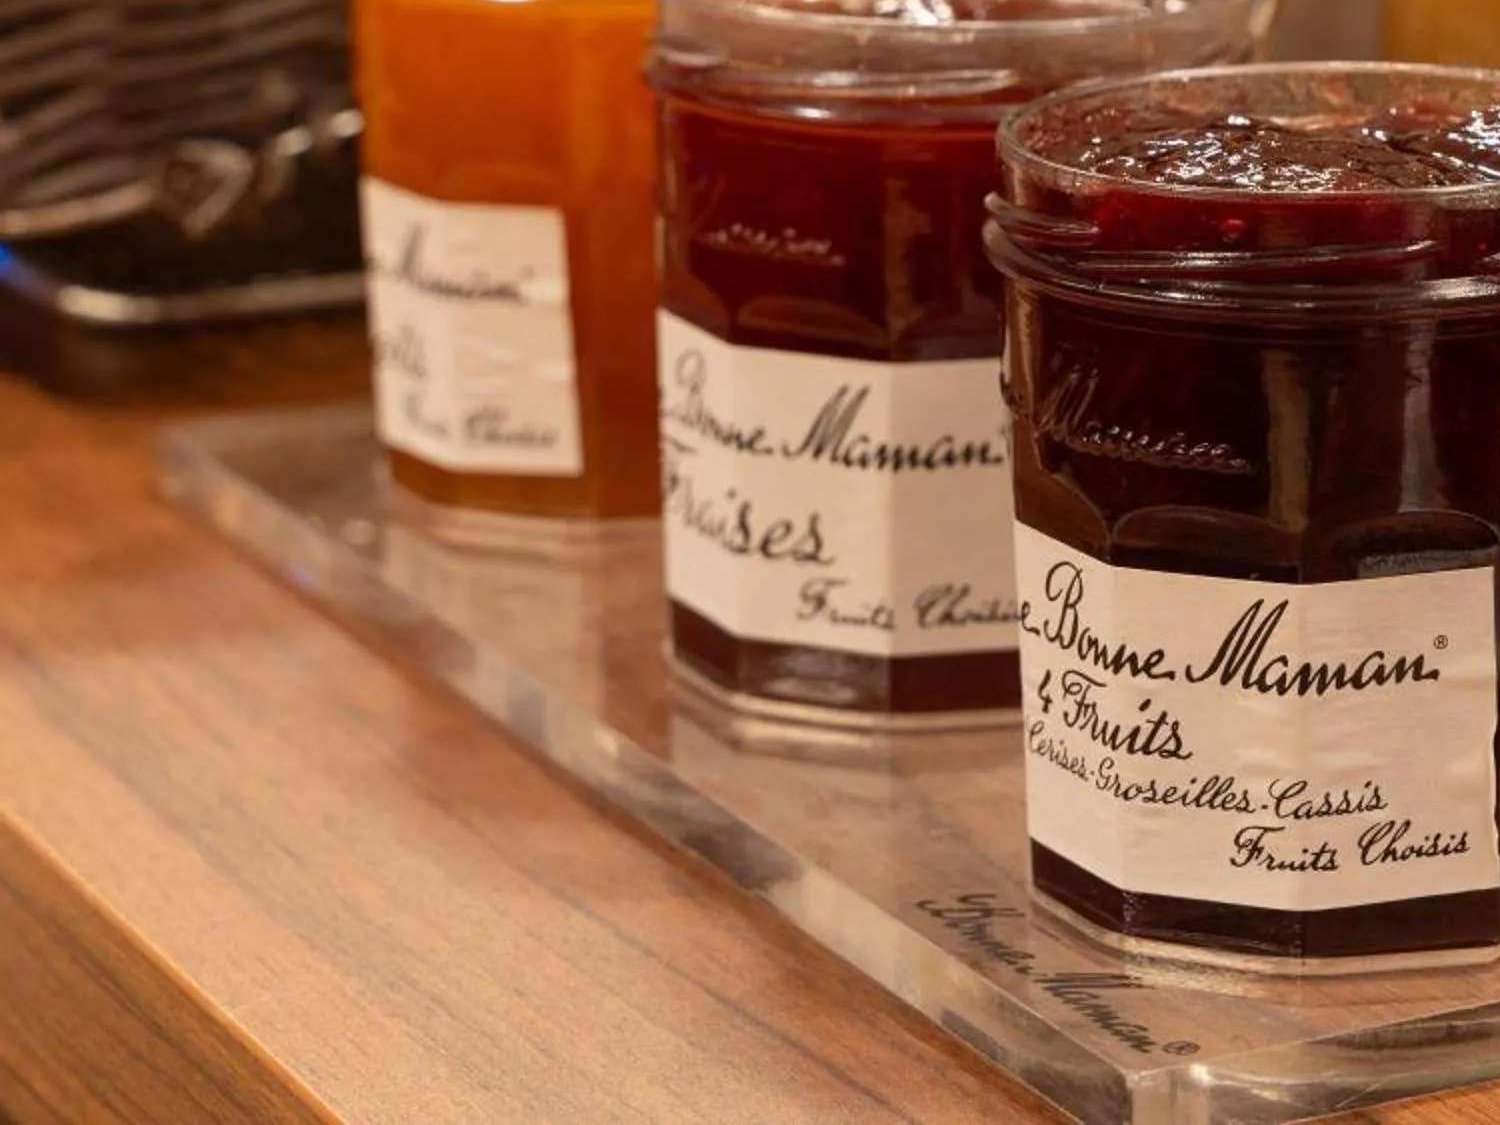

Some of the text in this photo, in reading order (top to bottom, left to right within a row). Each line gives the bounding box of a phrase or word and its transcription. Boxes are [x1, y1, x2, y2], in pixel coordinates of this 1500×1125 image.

[1043, 560, 1176, 681] Bonne
[1038, 669, 1193, 760] 4 Fruits
[1229, 819, 1470, 872] Fruits Choisis
